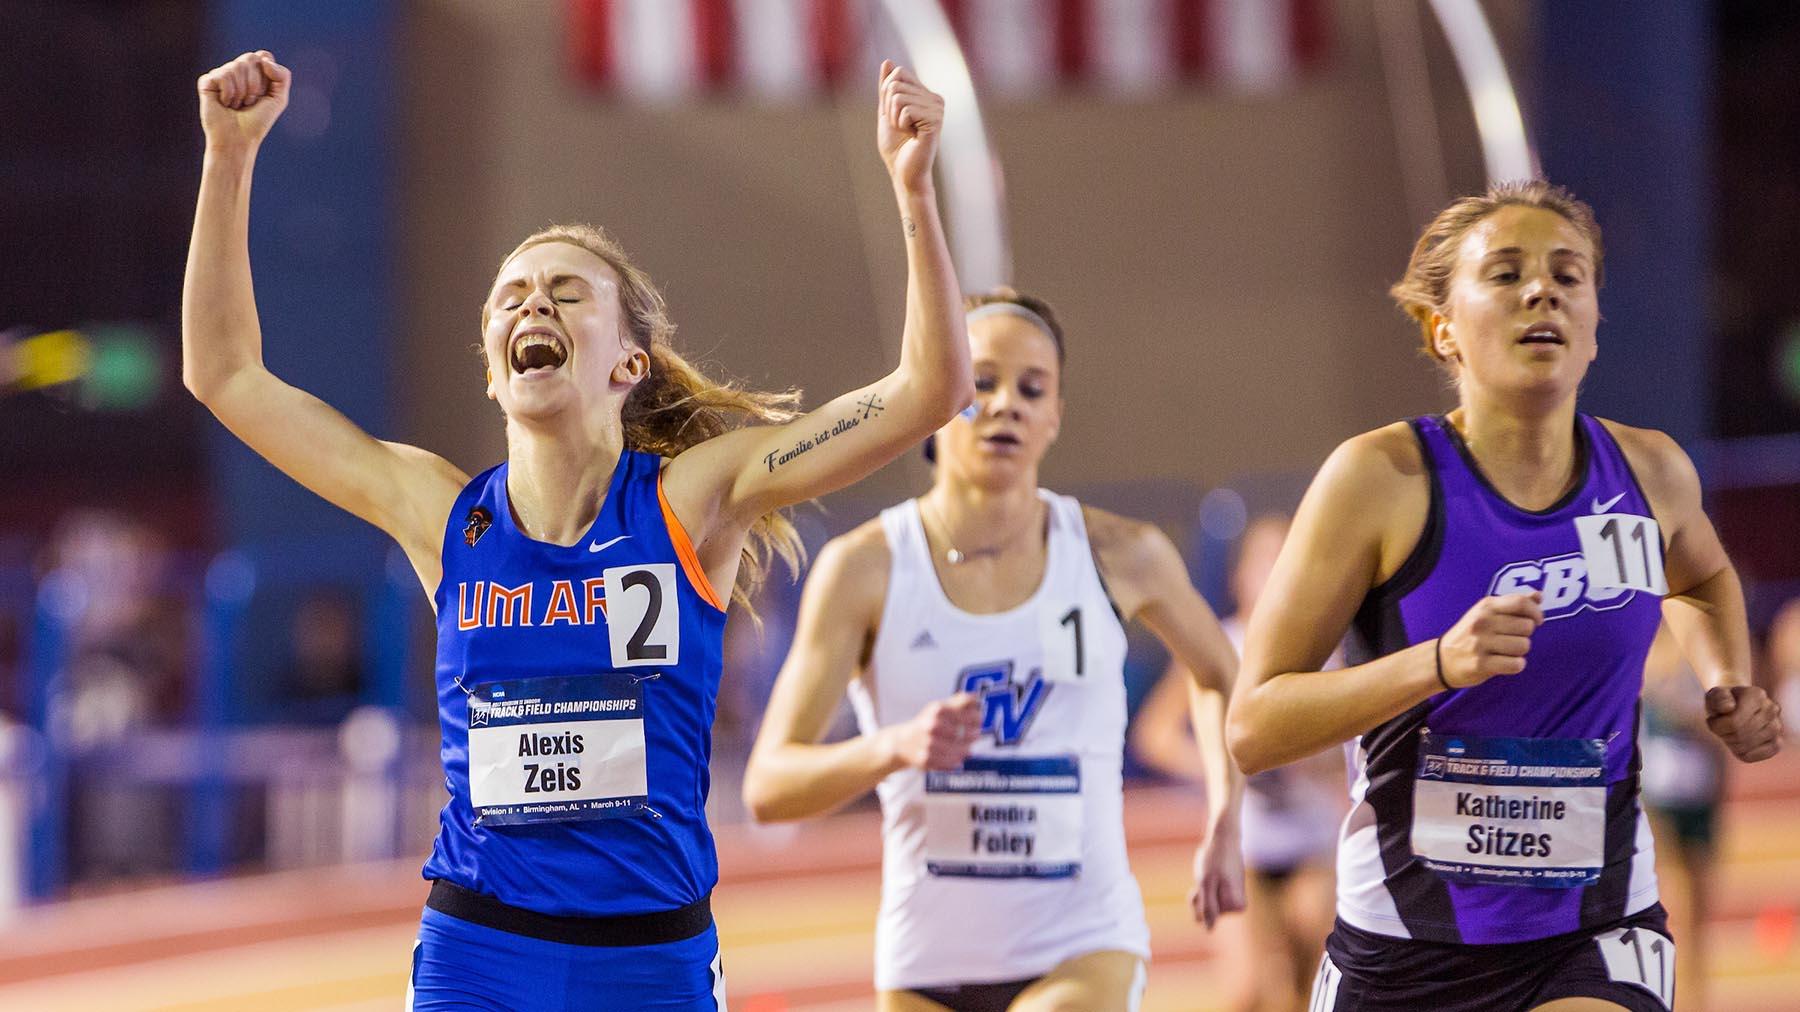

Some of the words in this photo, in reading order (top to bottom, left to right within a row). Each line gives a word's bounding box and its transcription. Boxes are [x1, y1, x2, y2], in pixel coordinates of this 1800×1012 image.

[763, 440, 814, 472] Familie
[815, 430, 831, 445] ist
[832, 418, 860, 436] alles
[1599, 518, 1653, 588] 11
[620, 569, 668, 661] 2
[1059, 606, 1085, 677] 1
[490, 705, 518, 719] TRACK
[518, 705, 524, 717] &
[525, 703, 552, 716] FIELD
[553, 699, 637, 715] CHAMPIONSHIPS
[518, 731, 585, 757] Alexis
[523, 763, 581, 793] Zeis
[1447, 762, 1480, 775] TRACK
[1488, 765, 1518, 777] FIELD
[1519, 765, 1602, 778] CHAMPIONSHIPS
[482, 808, 507, 816] Division
[523, 805, 568, 814] Birmingham,
[1456, 792, 1566, 820] Katherine
[972, 829, 1035, 857] Foley
[1466, 824, 1552, 857] Sitzes
[1619, 929, 1666, 1000] 11
